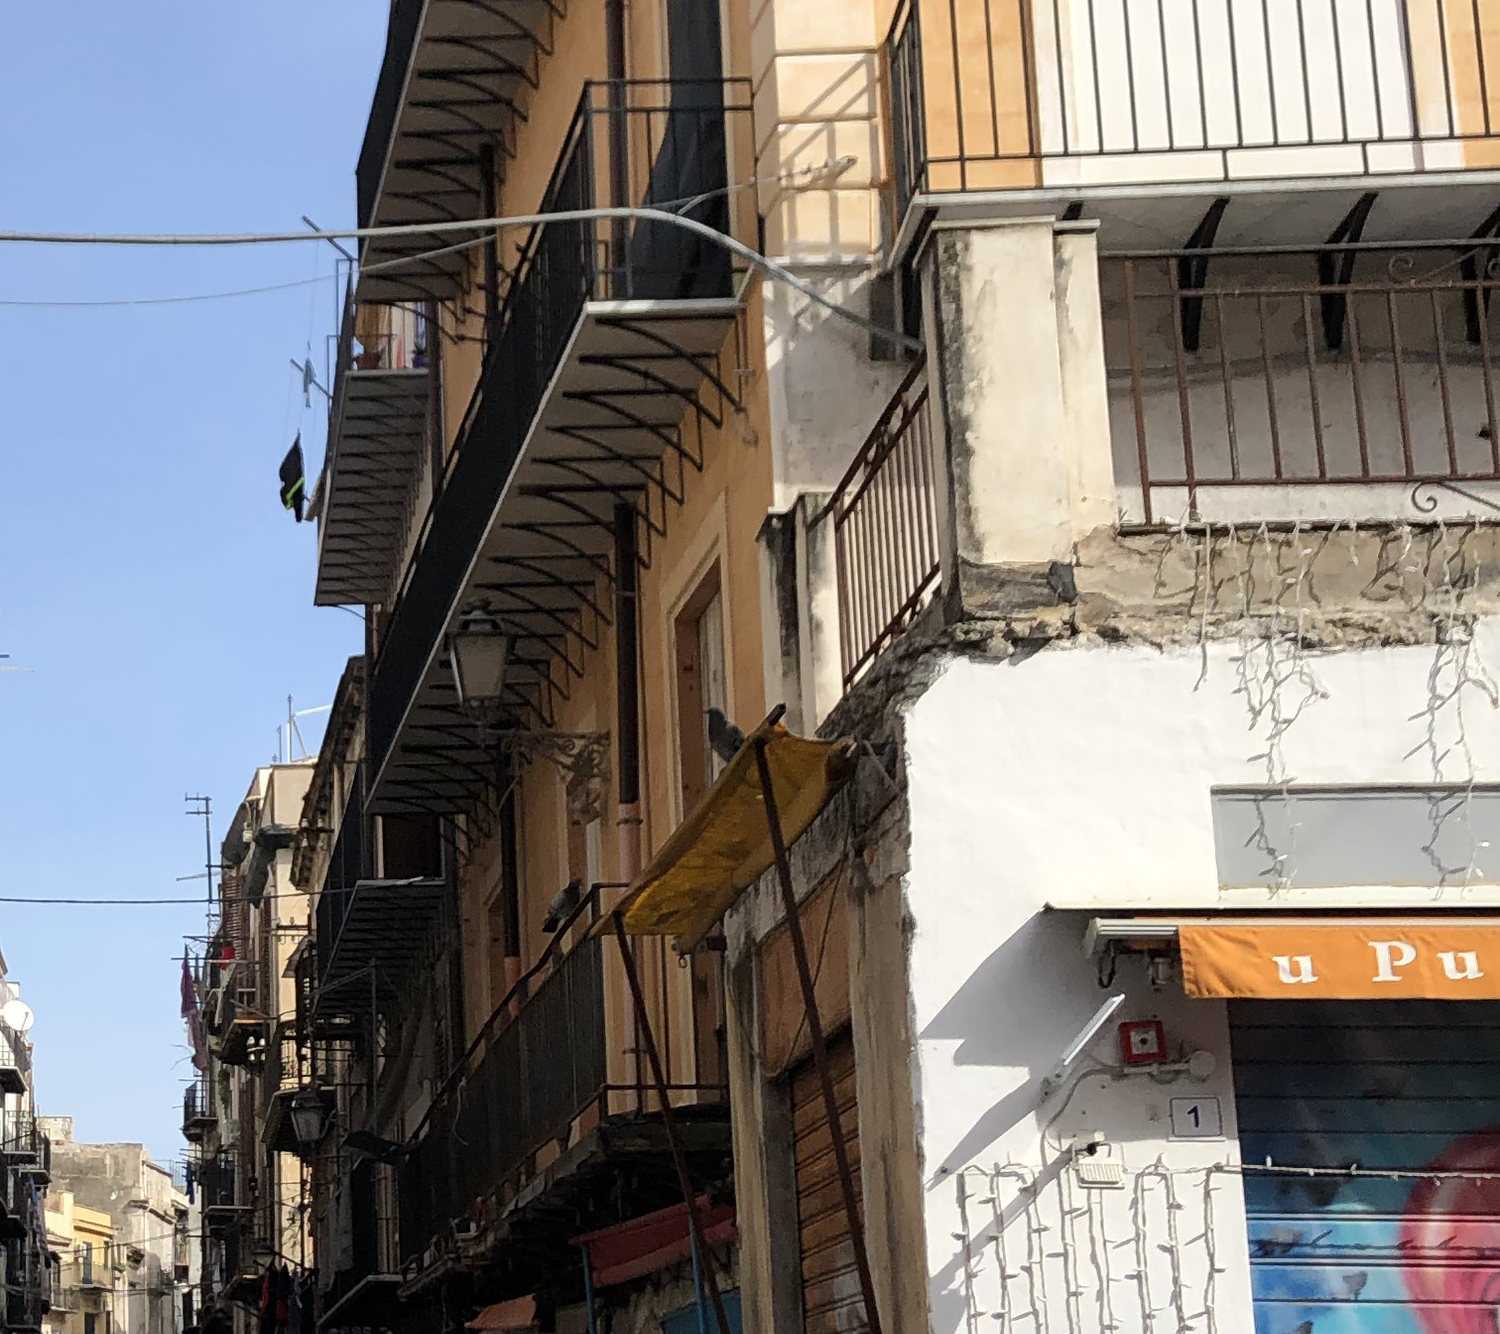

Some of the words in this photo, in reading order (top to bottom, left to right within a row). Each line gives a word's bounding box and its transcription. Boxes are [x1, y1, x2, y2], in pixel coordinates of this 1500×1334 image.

[1273, 953, 1319, 984] u
[1367, 940, 1485, 983] Pu
[1186, 1104, 1200, 1129] 1
